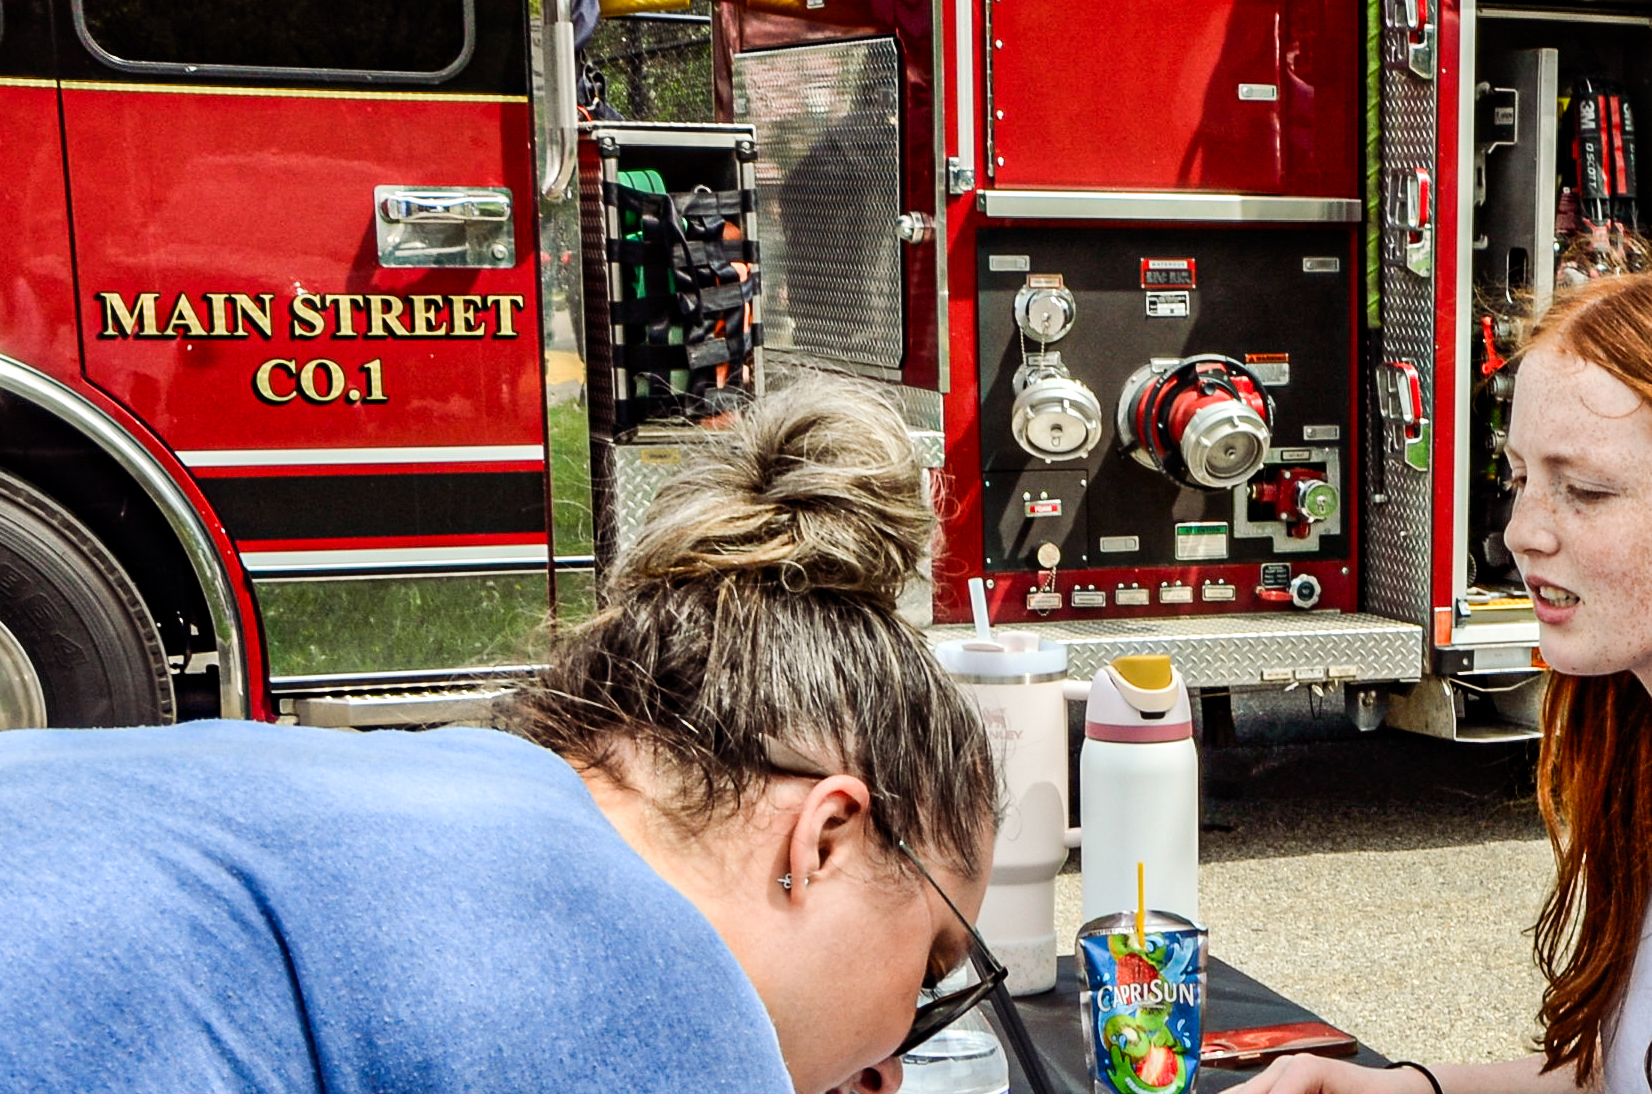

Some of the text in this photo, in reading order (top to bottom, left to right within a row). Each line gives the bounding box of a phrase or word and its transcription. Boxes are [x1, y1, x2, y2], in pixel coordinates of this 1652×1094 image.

[1580, 101, 1596, 129] 3M
[1586, 153, 1598, 188] SCOTT
[99, 292, 524, 340] MAIN STREET
[253, 358, 388, 404] CO.1
